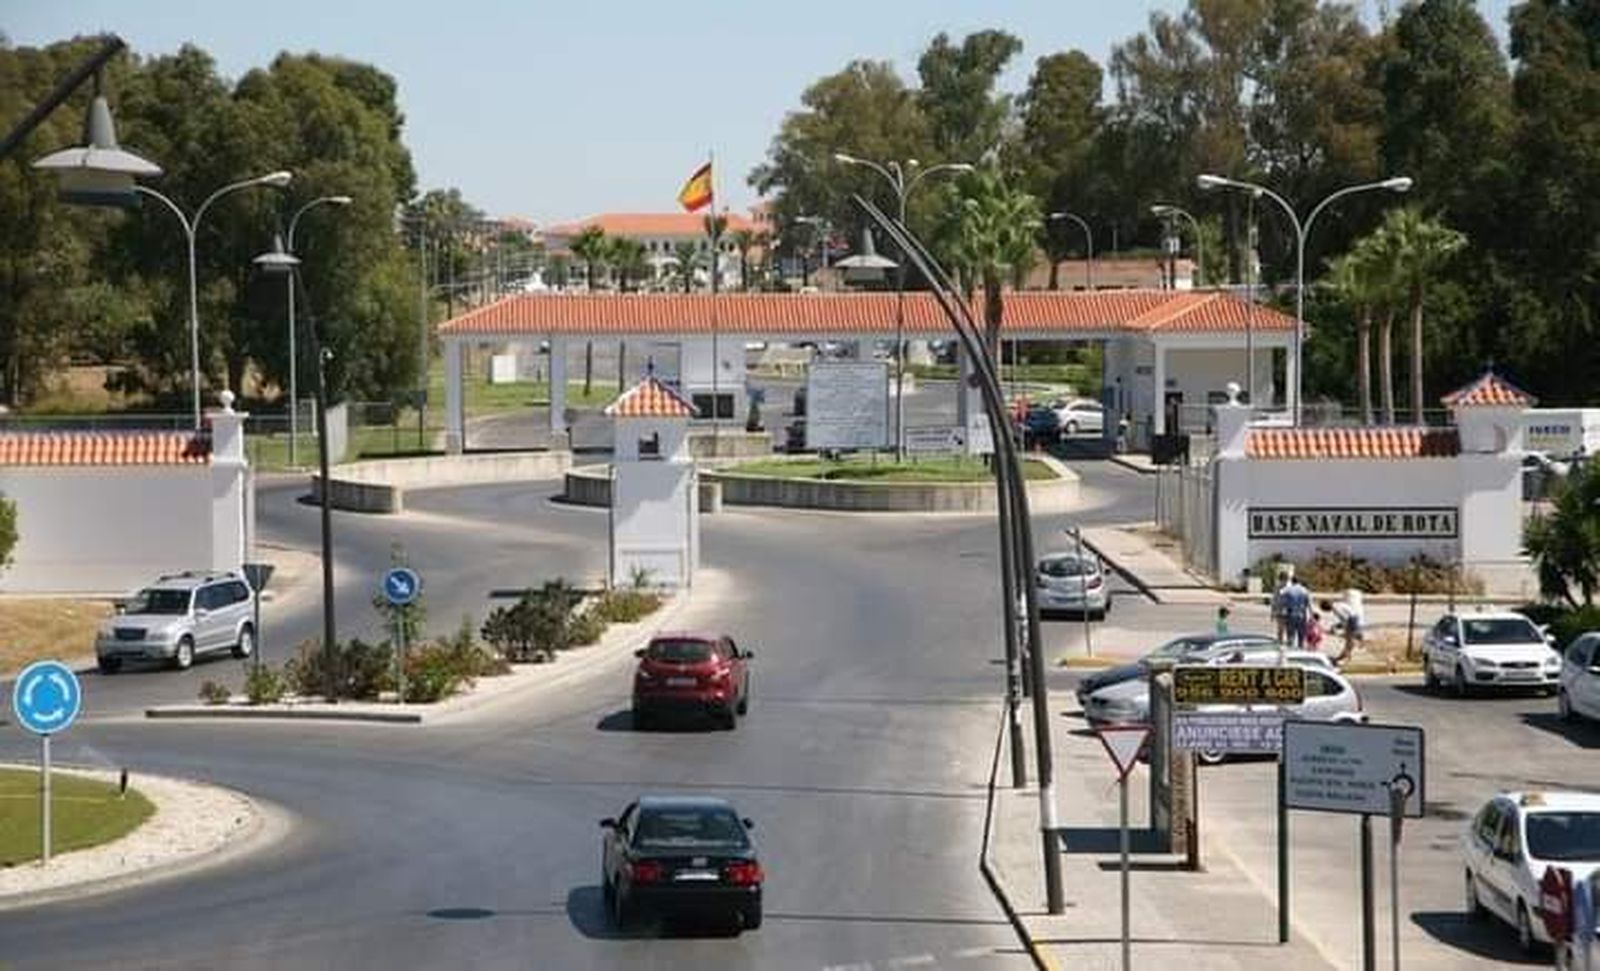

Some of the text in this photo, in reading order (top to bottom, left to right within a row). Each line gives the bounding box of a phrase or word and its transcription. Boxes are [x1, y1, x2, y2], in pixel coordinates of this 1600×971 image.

[1253, 514, 1452, 532] BASE NAVAL DE ROTA
[1219, 670, 1260, 687] RENT
[1262, 670, 1271, 687] A
[1274, 670, 1301, 687] CAR
